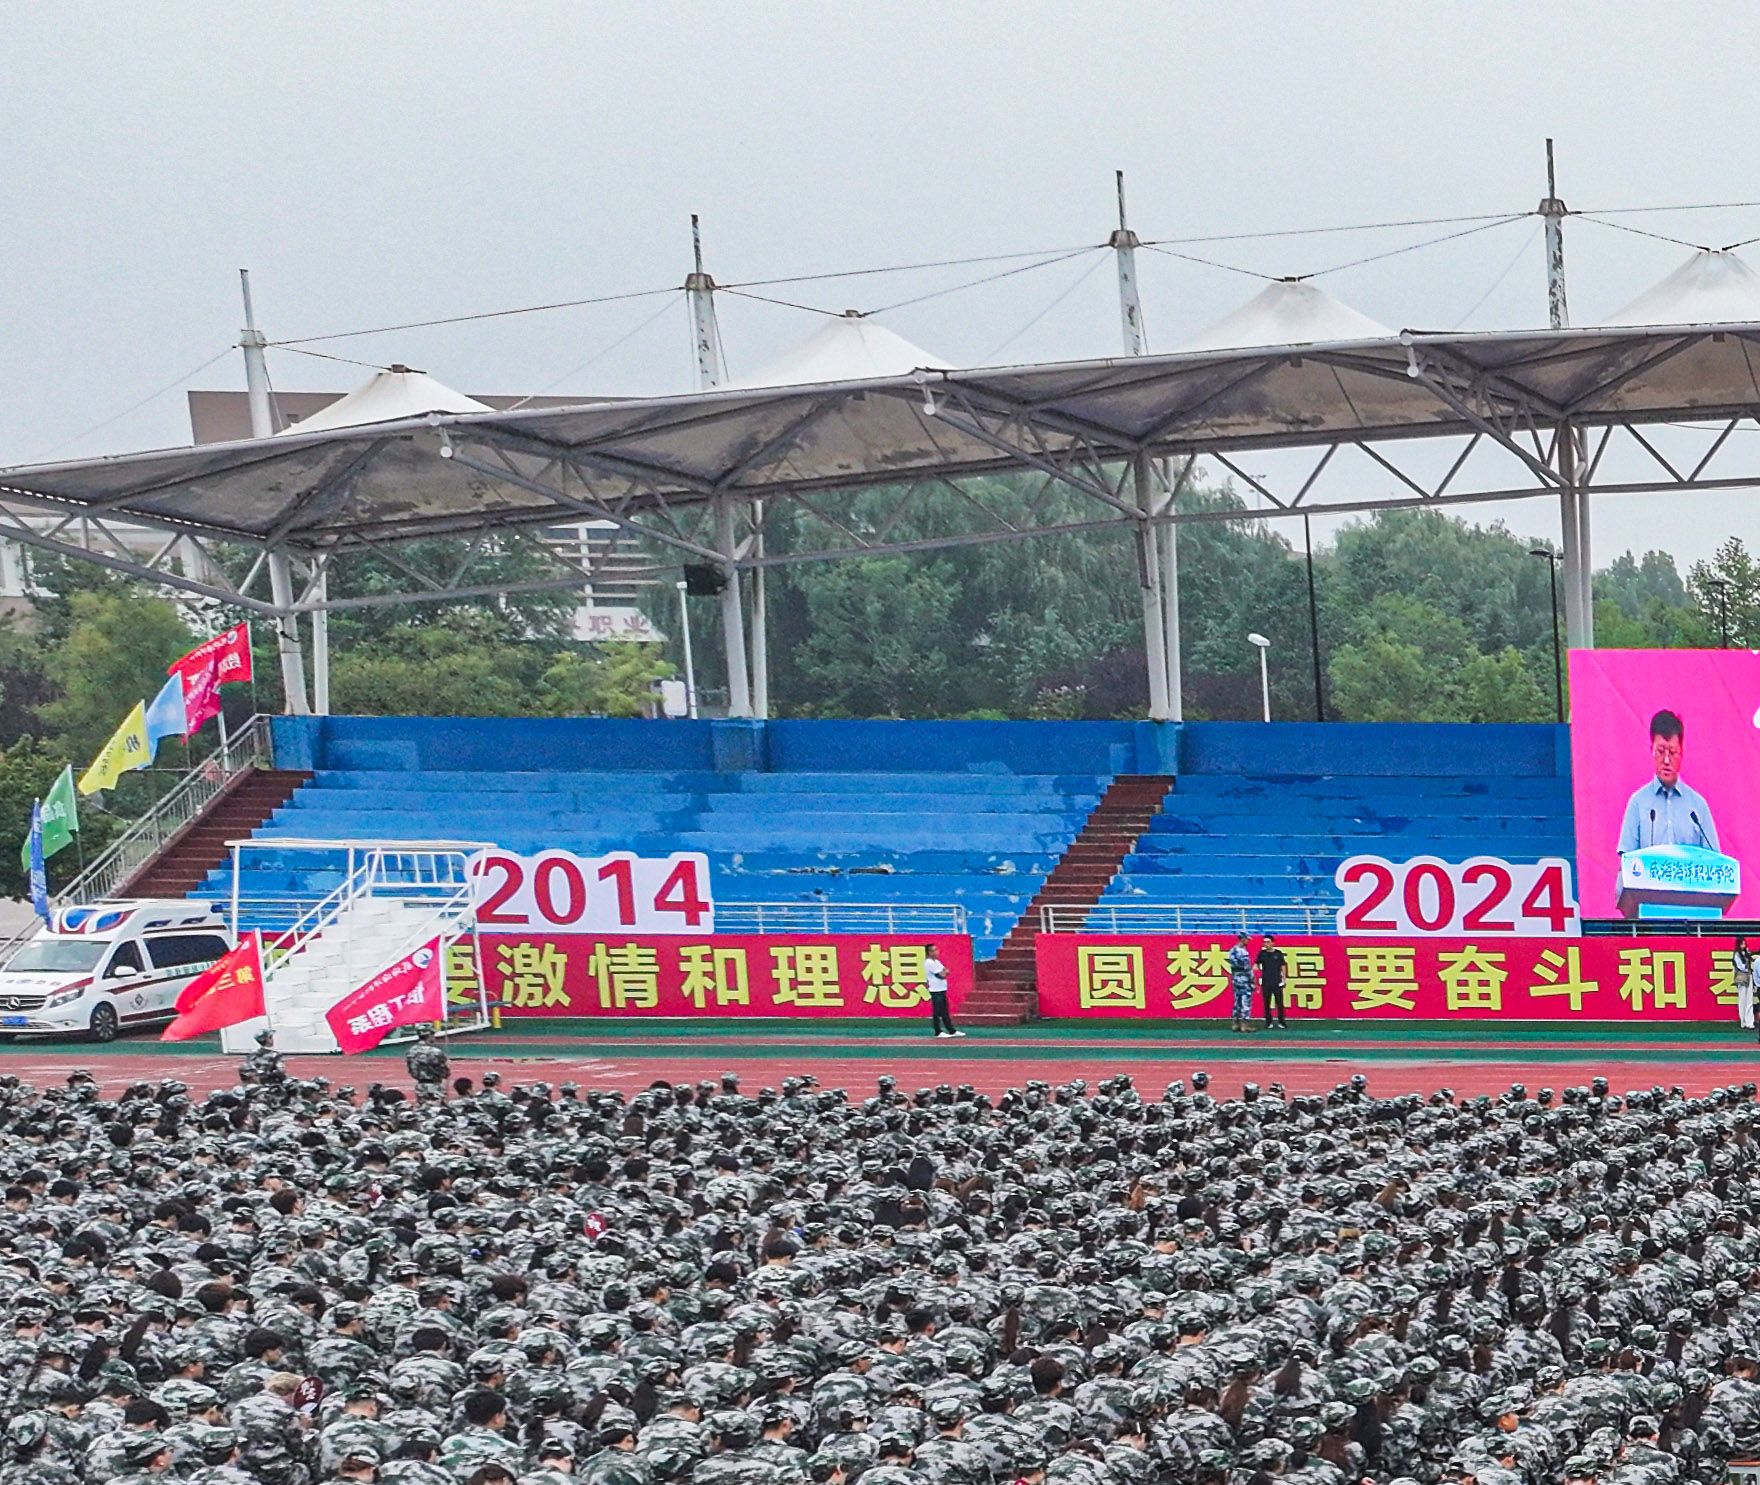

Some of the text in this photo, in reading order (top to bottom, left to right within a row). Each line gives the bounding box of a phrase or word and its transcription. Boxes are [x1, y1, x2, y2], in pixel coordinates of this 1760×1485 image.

[572, 614, 650, 635] 职业
[472, 856, 710, 927] 2014
[1650, 859, 1735, 884] 威海海洋职业学院
[1343, 862, 1575, 933] 2024
